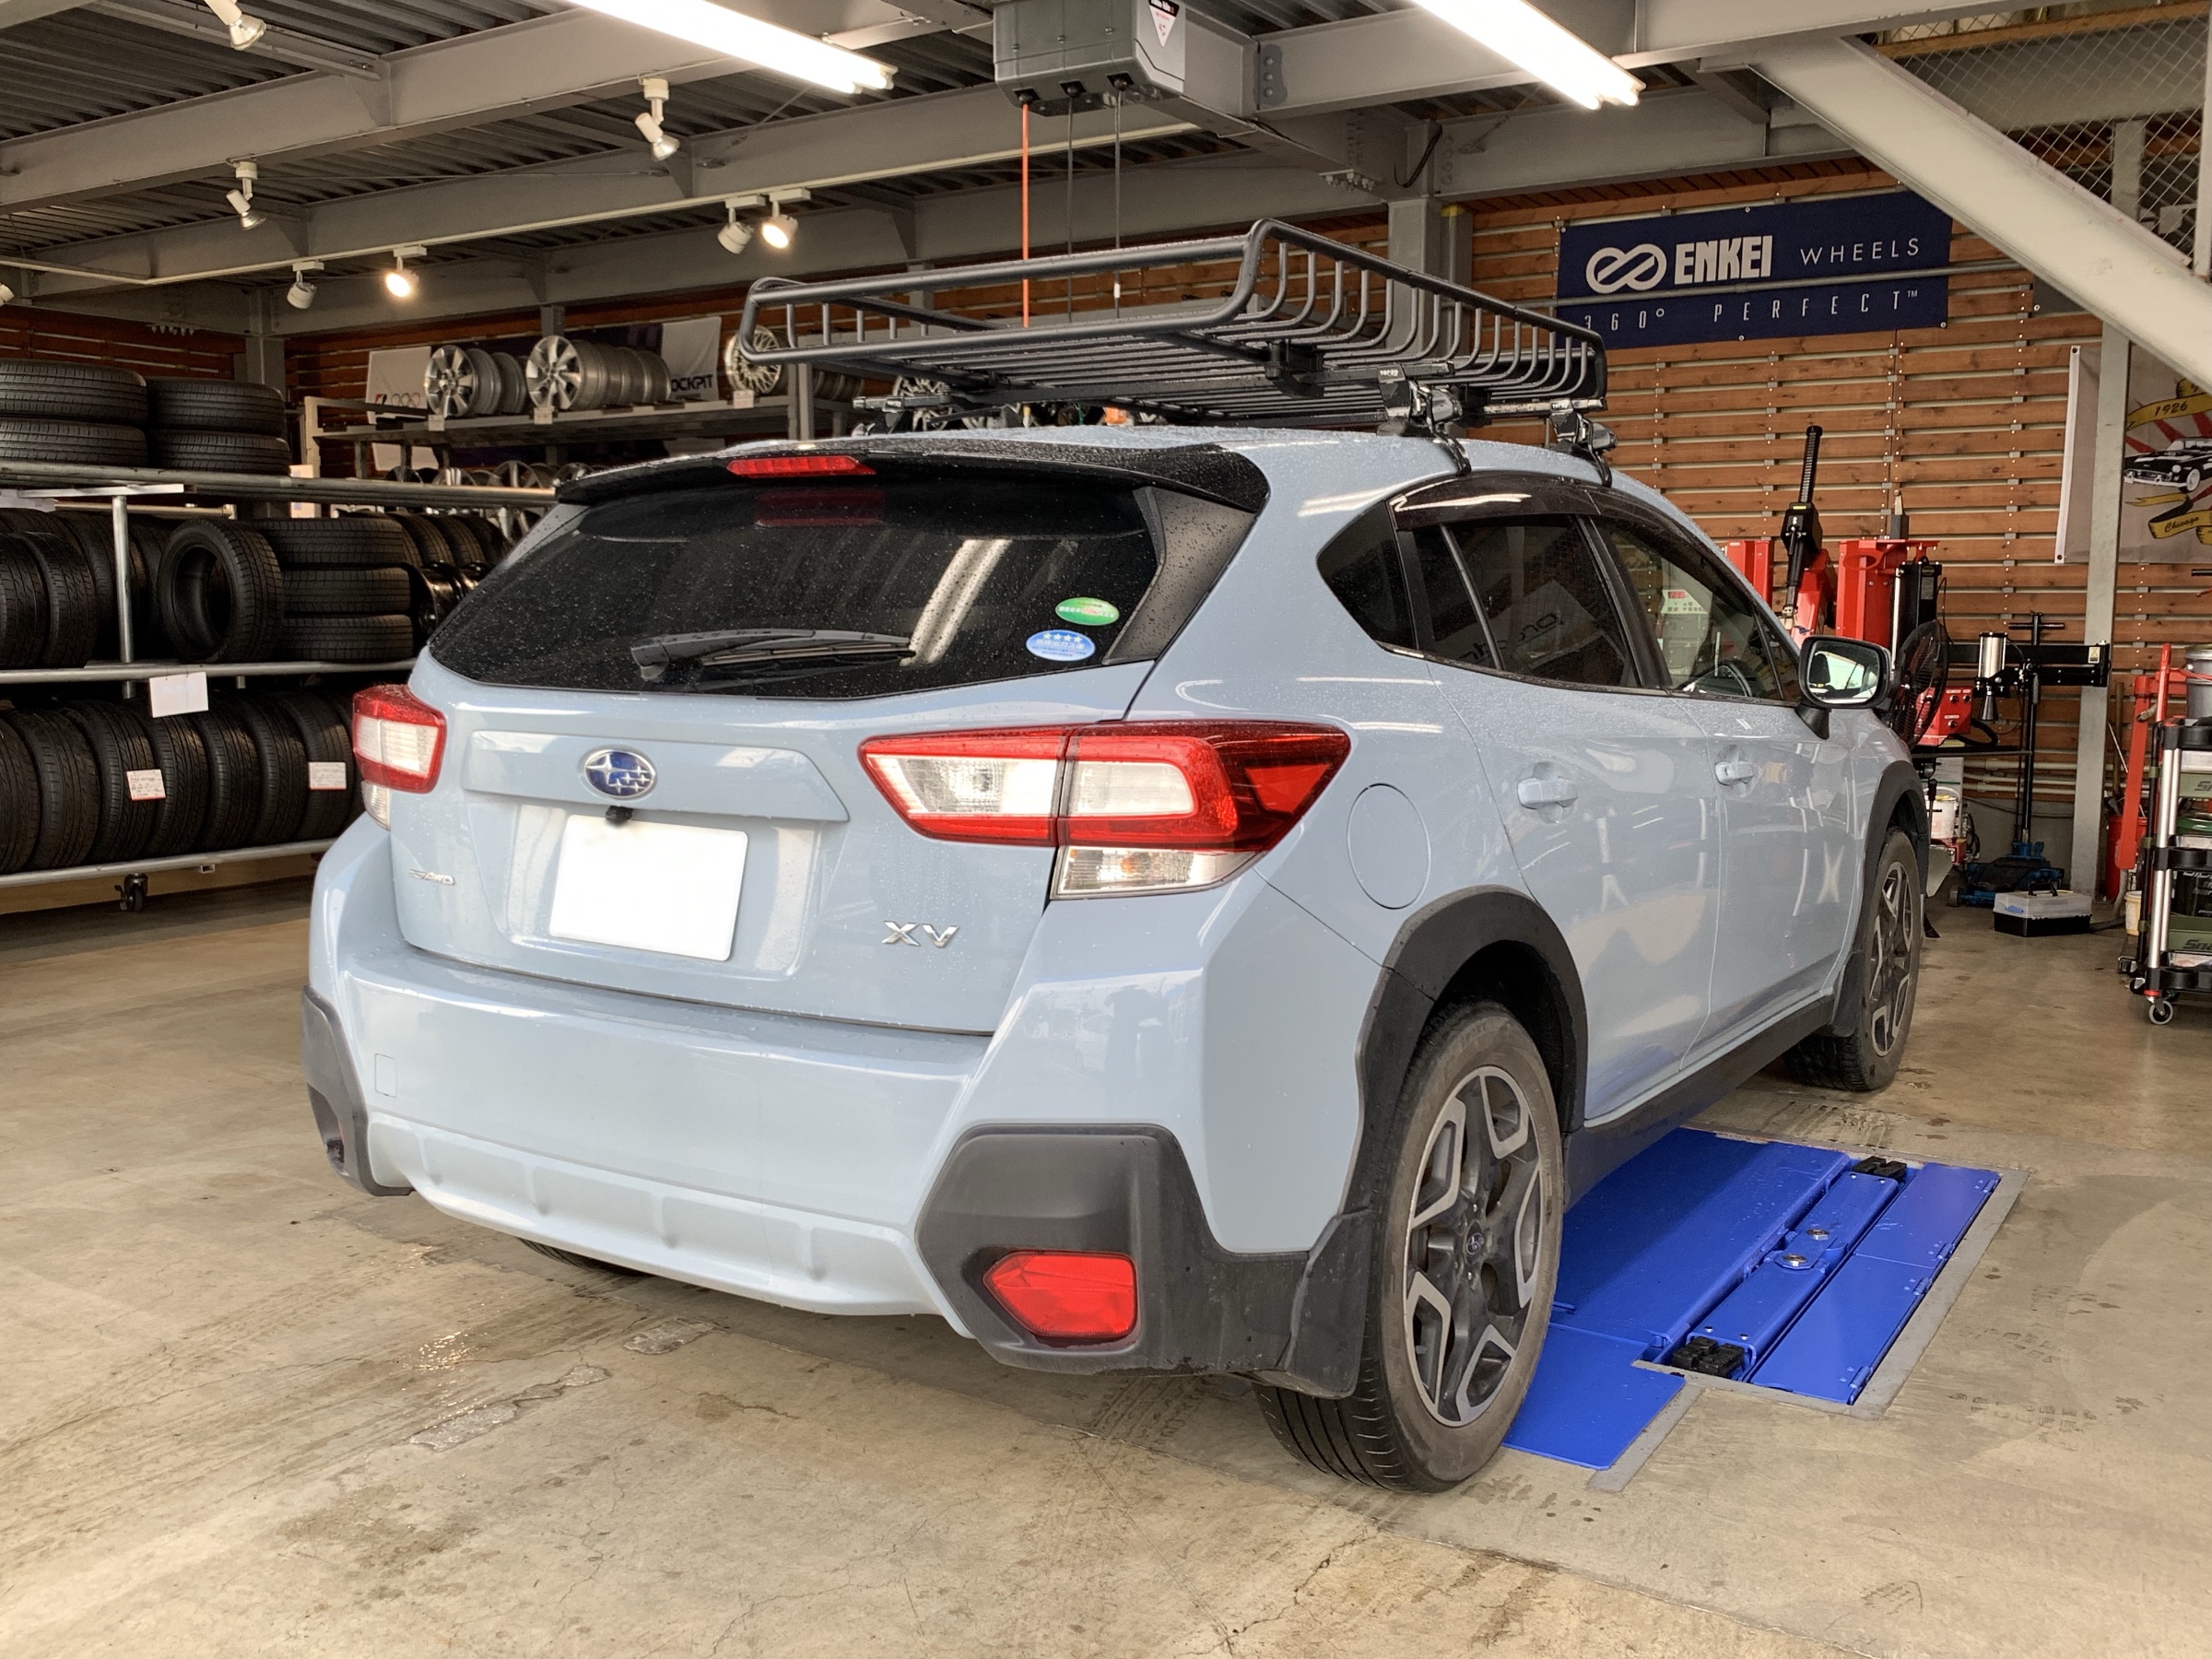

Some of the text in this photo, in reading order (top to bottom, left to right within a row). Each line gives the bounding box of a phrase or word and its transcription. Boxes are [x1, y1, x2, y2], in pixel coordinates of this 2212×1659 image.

[1674, 235, 1919, 285] ENKEI WHEELS
[671, 373, 713, 392] OCKPIT
[2154, 400, 2189, 417] 1926
[2164, 516, 2200, 533] Chicago
[881, 920, 960, 948] XV
